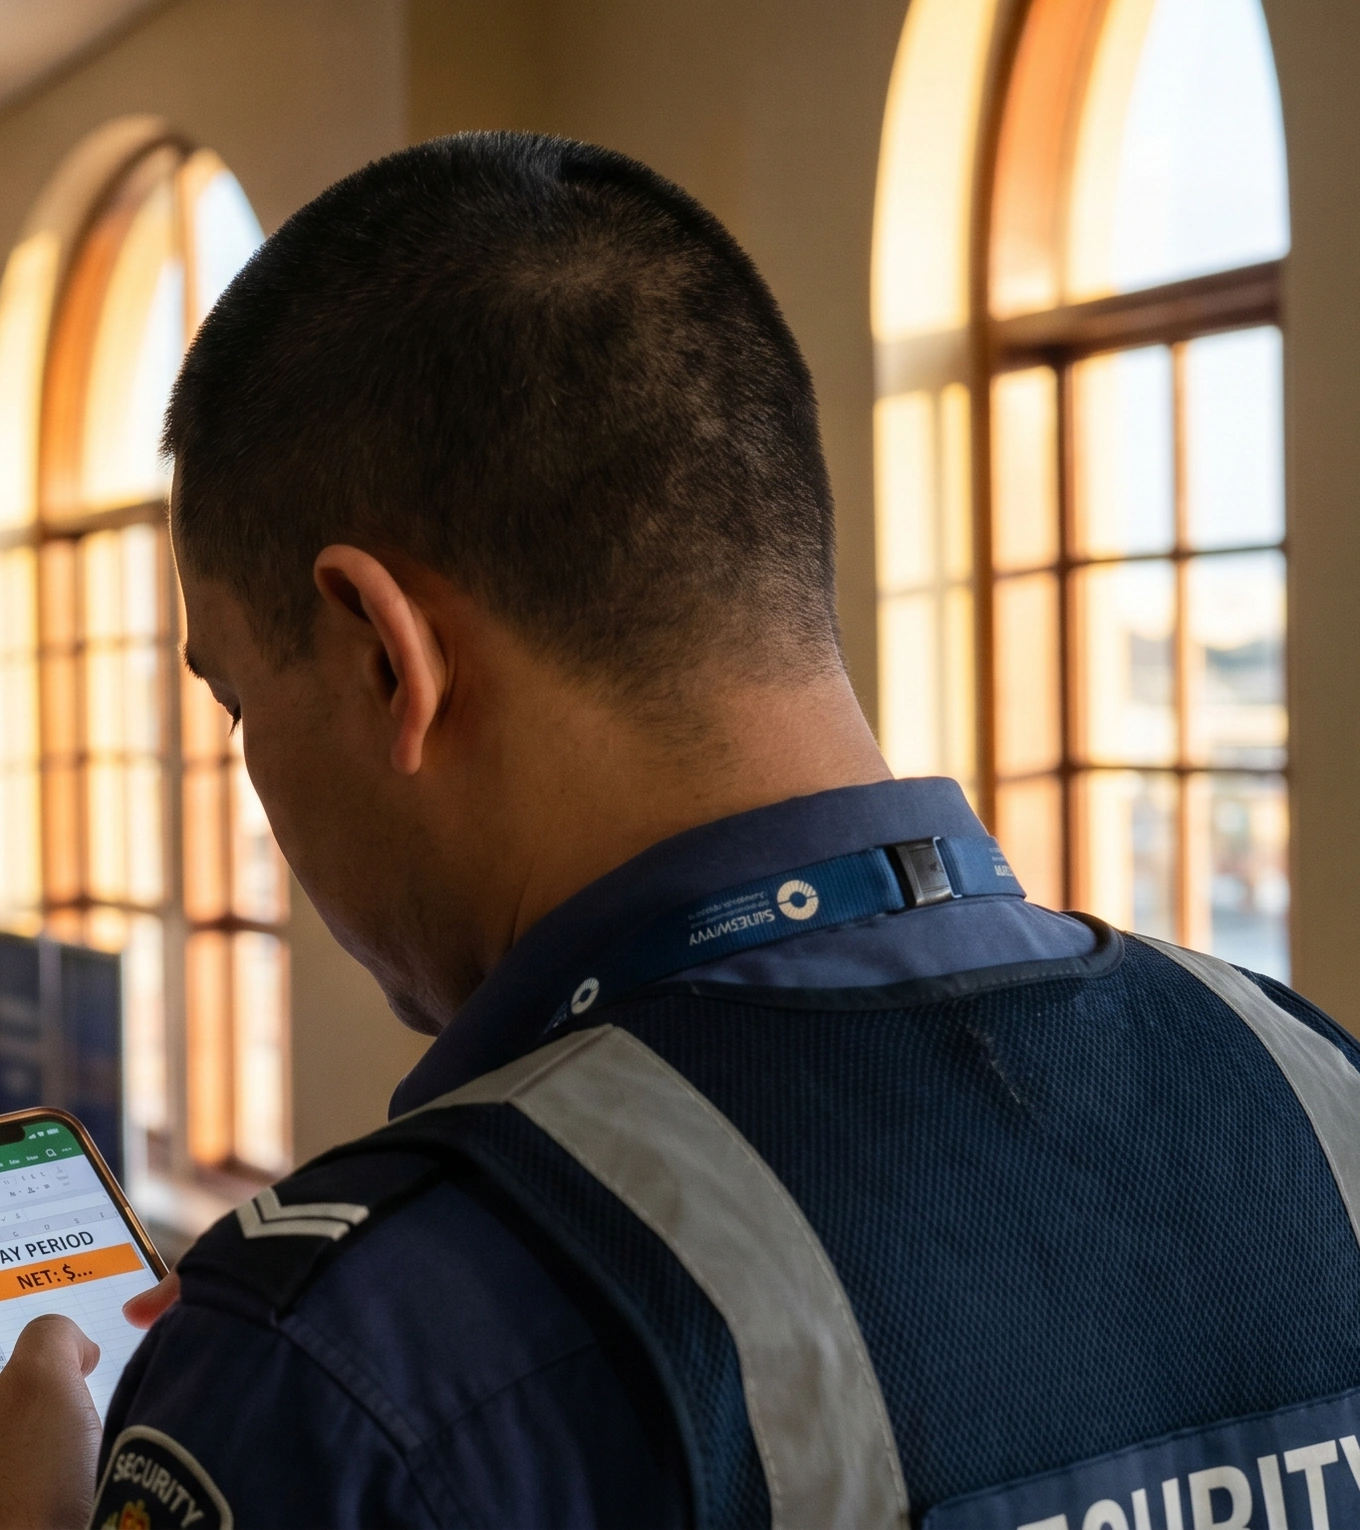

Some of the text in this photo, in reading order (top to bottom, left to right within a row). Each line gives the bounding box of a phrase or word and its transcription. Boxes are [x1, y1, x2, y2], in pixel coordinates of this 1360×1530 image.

[25, 1230, 94, 1259] PERIOD
[16, 1269, 61, 1290] NET:
[113, 1452, 205, 1528] SECURITY
